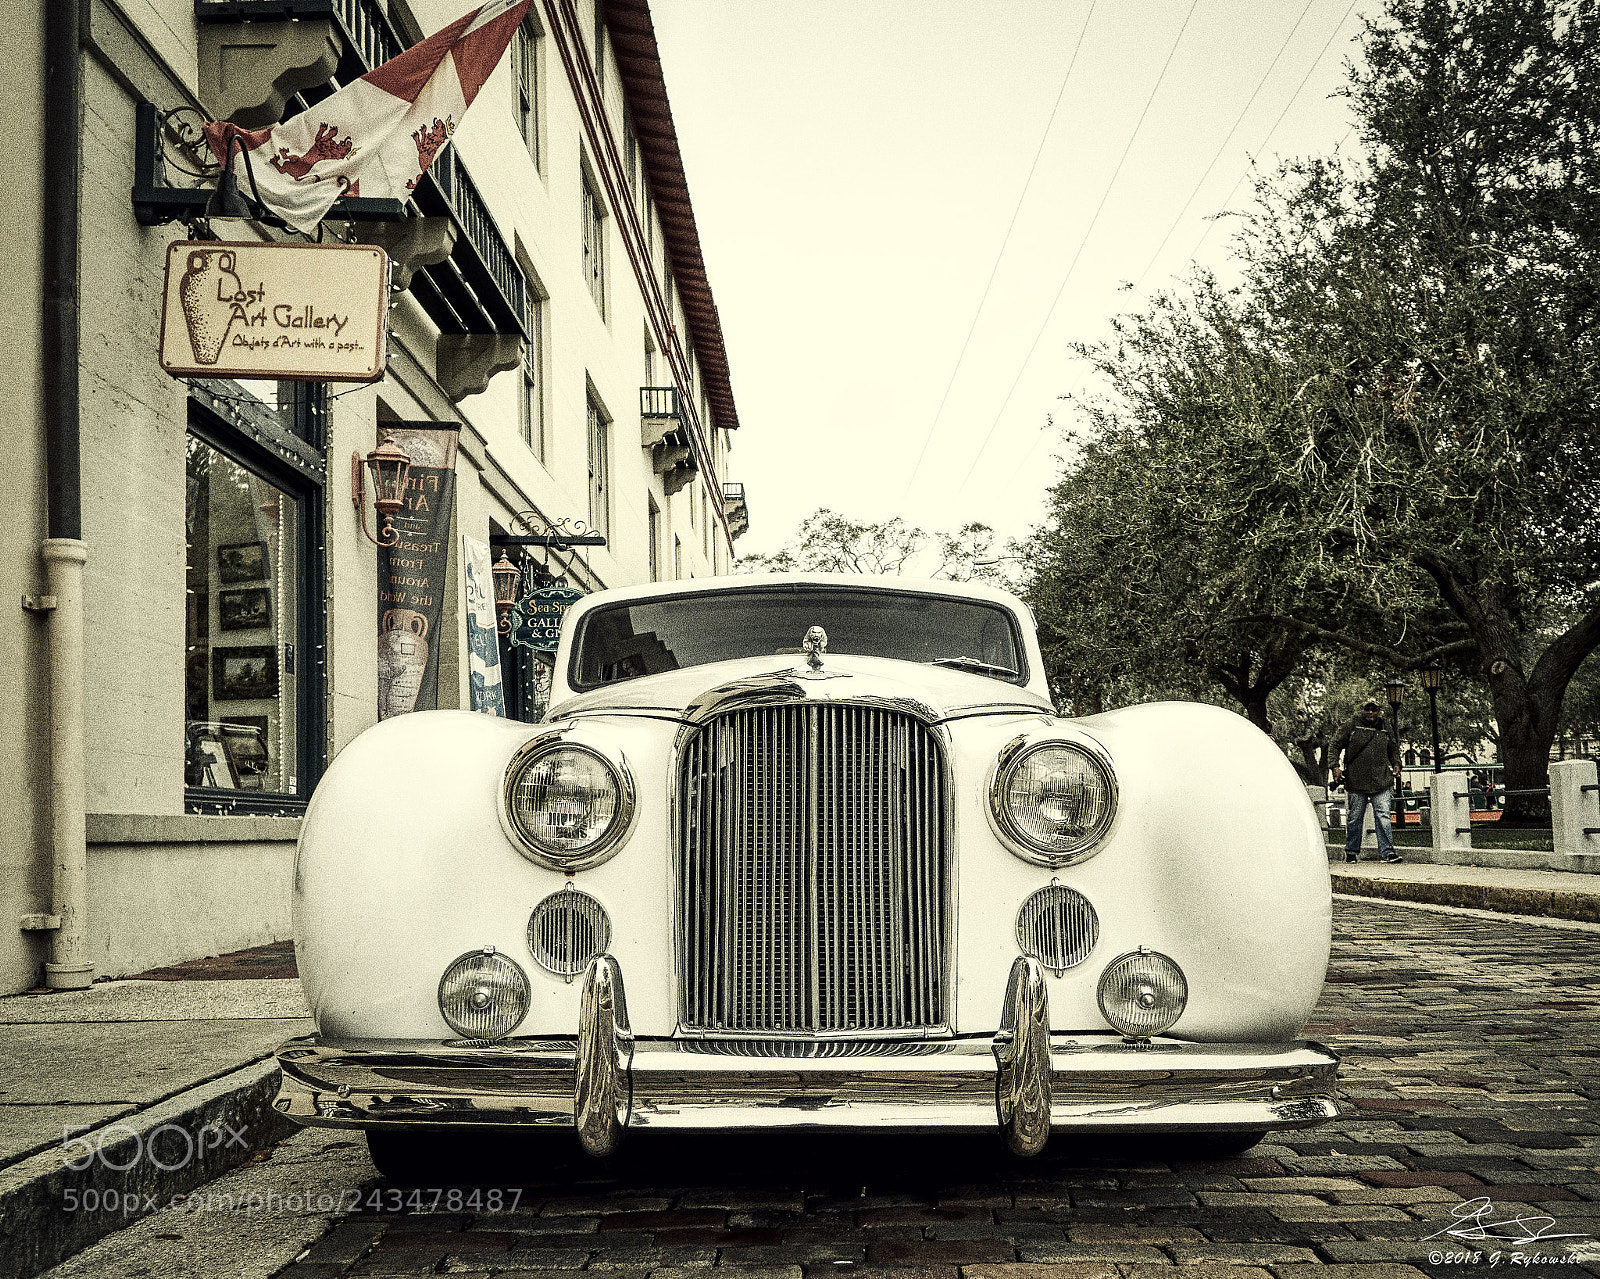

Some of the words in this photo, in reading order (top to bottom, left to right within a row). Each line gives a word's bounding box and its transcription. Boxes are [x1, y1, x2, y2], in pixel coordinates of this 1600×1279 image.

[217, 277, 265, 308] Lost
[228, 302, 268, 327] Art
[273, 304, 349, 337] Gallery
[232, 334, 270, 351] Objets
[272, 335, 301, 348] d'Art
[304, 337, 326, 349] with
[328, 341, 335, 349] a
[527, 600, 549, 615] Sea
[531, 628, 543, 638] &
